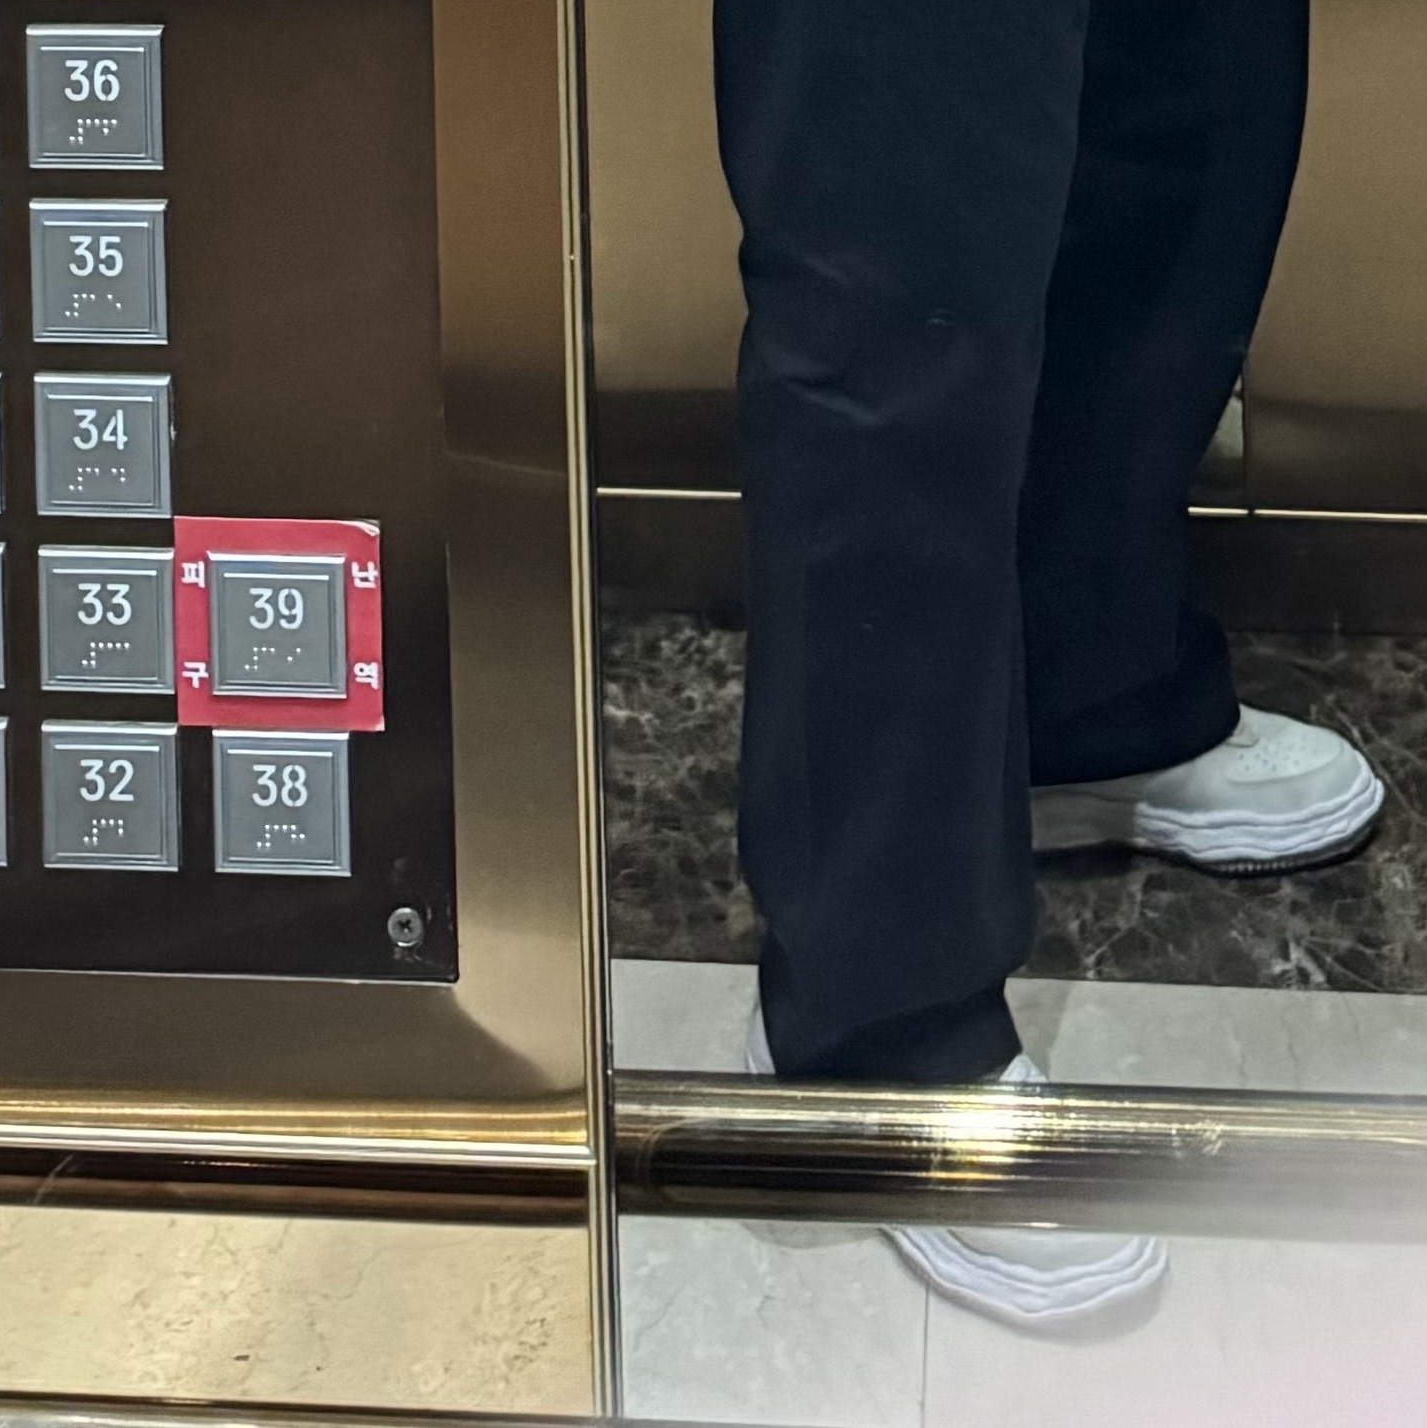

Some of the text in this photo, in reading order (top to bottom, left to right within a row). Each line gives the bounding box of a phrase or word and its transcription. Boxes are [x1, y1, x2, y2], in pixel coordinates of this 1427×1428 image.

[65, 60, 120, 101] 36
[69, 236, 123, 276] 35
[73, 409, 128, 450] 34
[78, 583, 131, 625] 33
[250, 588, 303, 629] 39
[182, 661, 209, 689] 구
[80, 759, 134, 801] 32
[252, 765, 307, 806] 38
